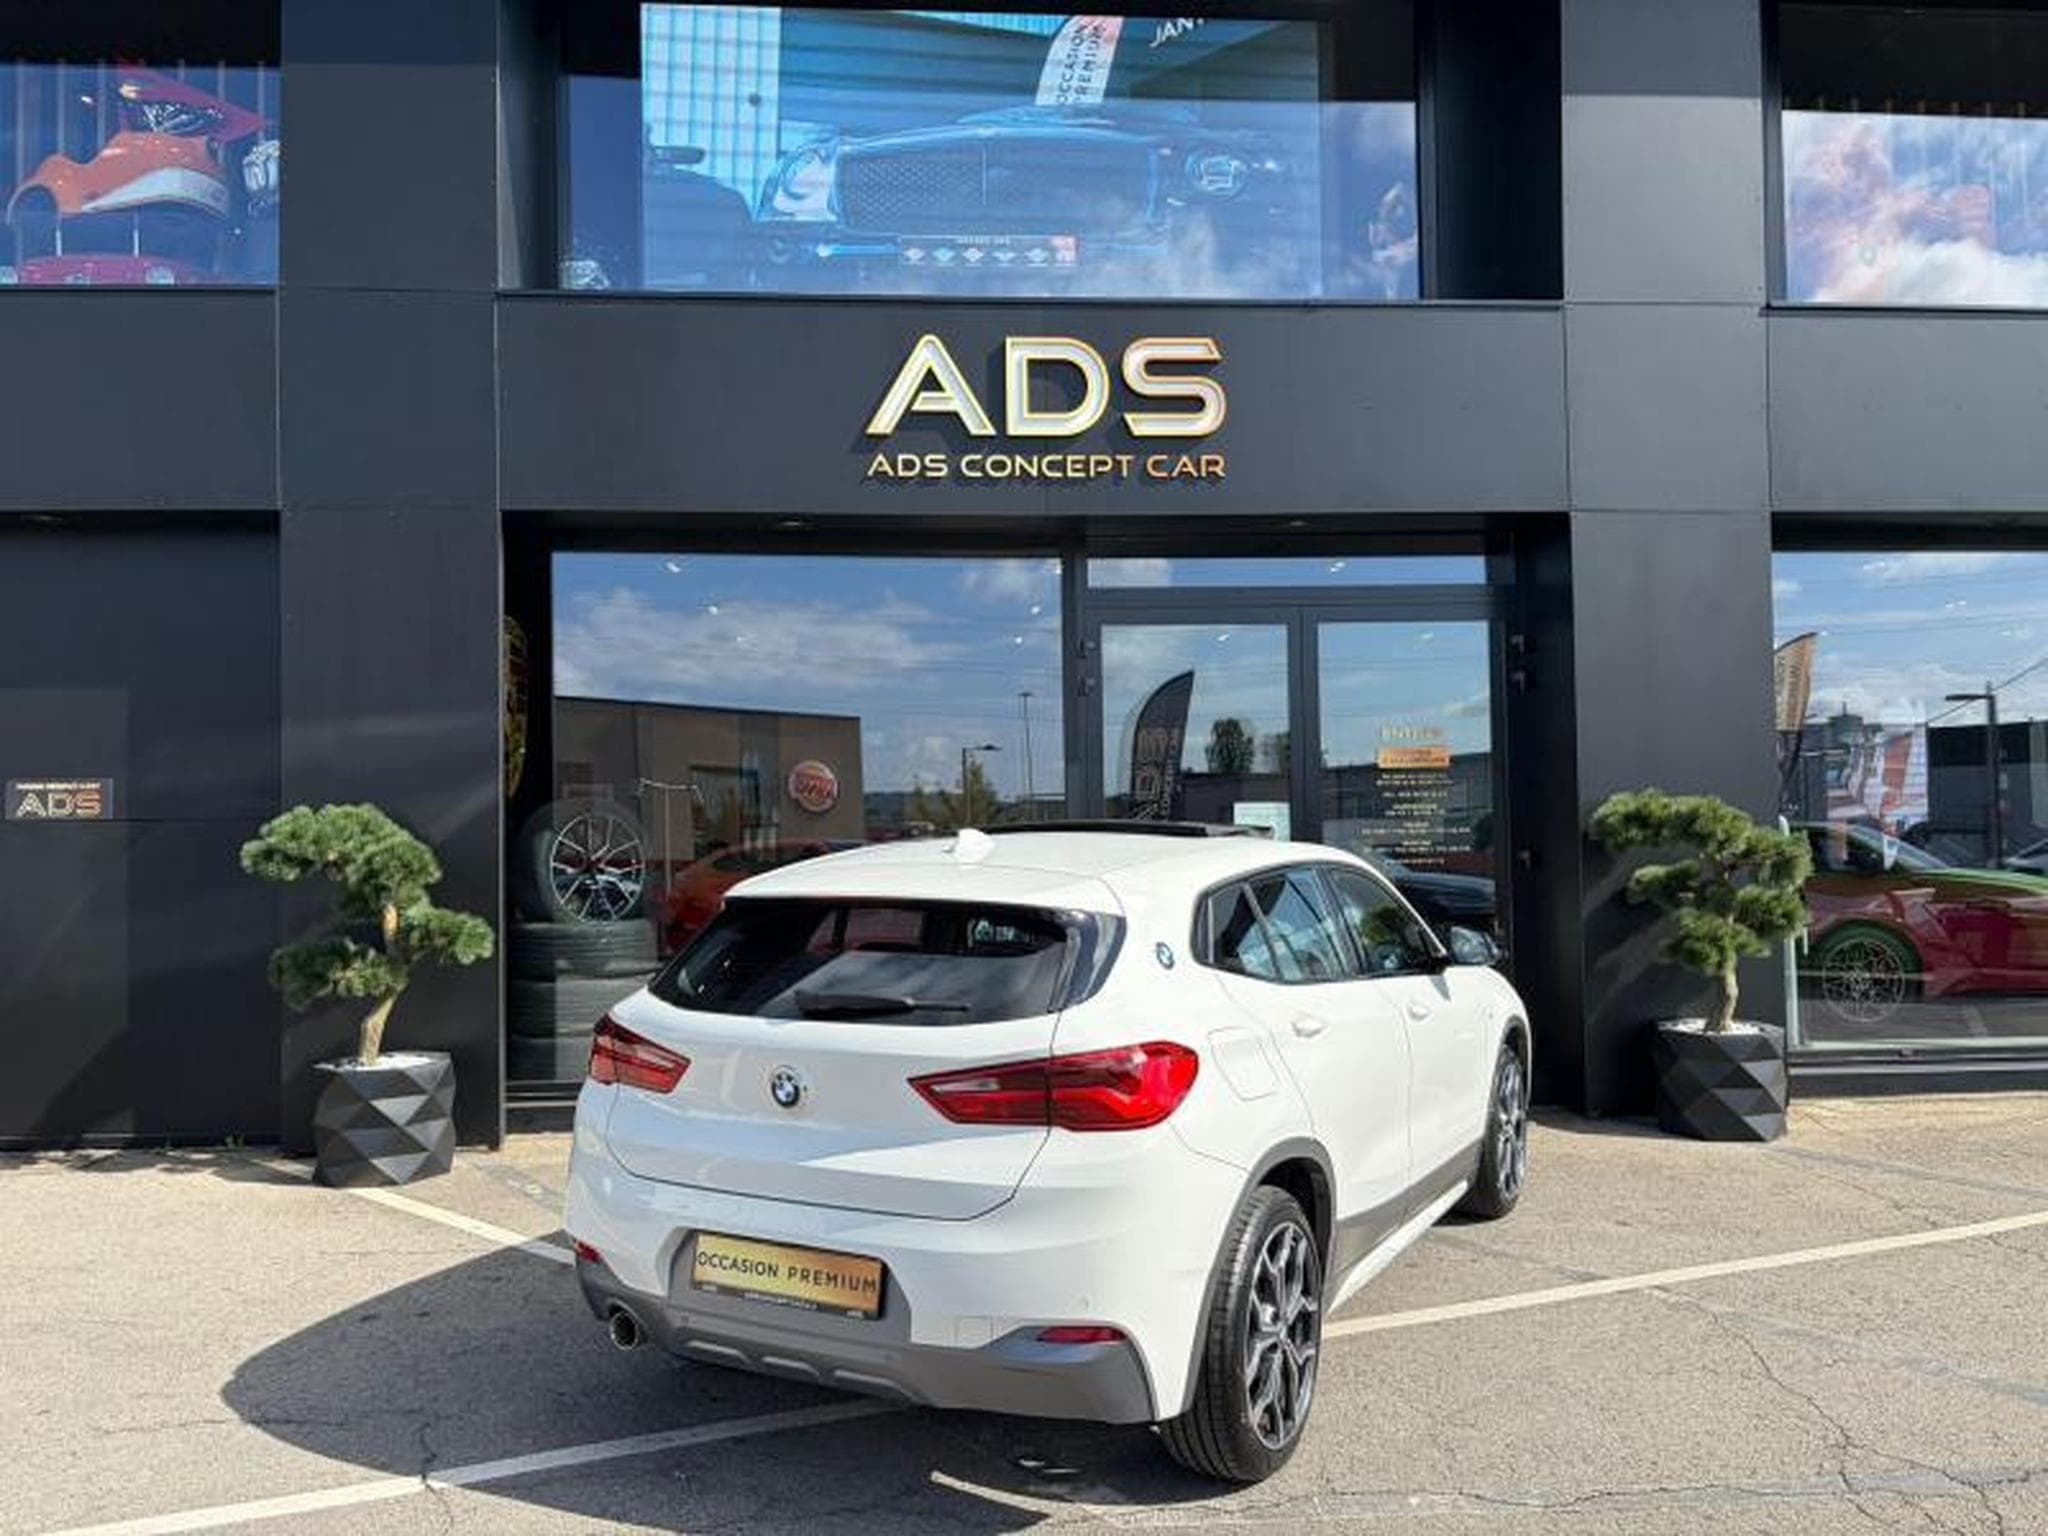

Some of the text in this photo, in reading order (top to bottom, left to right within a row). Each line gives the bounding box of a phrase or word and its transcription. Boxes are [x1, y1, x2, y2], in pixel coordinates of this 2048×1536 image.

[866, 334, 1226, 437] ADS
[867, 453, 1226, 478] ADS CONCEPT CAR
[16, 792, 102, 818] ADS
[697, 1250, 876, 1294] OCCASION PREMIUM
